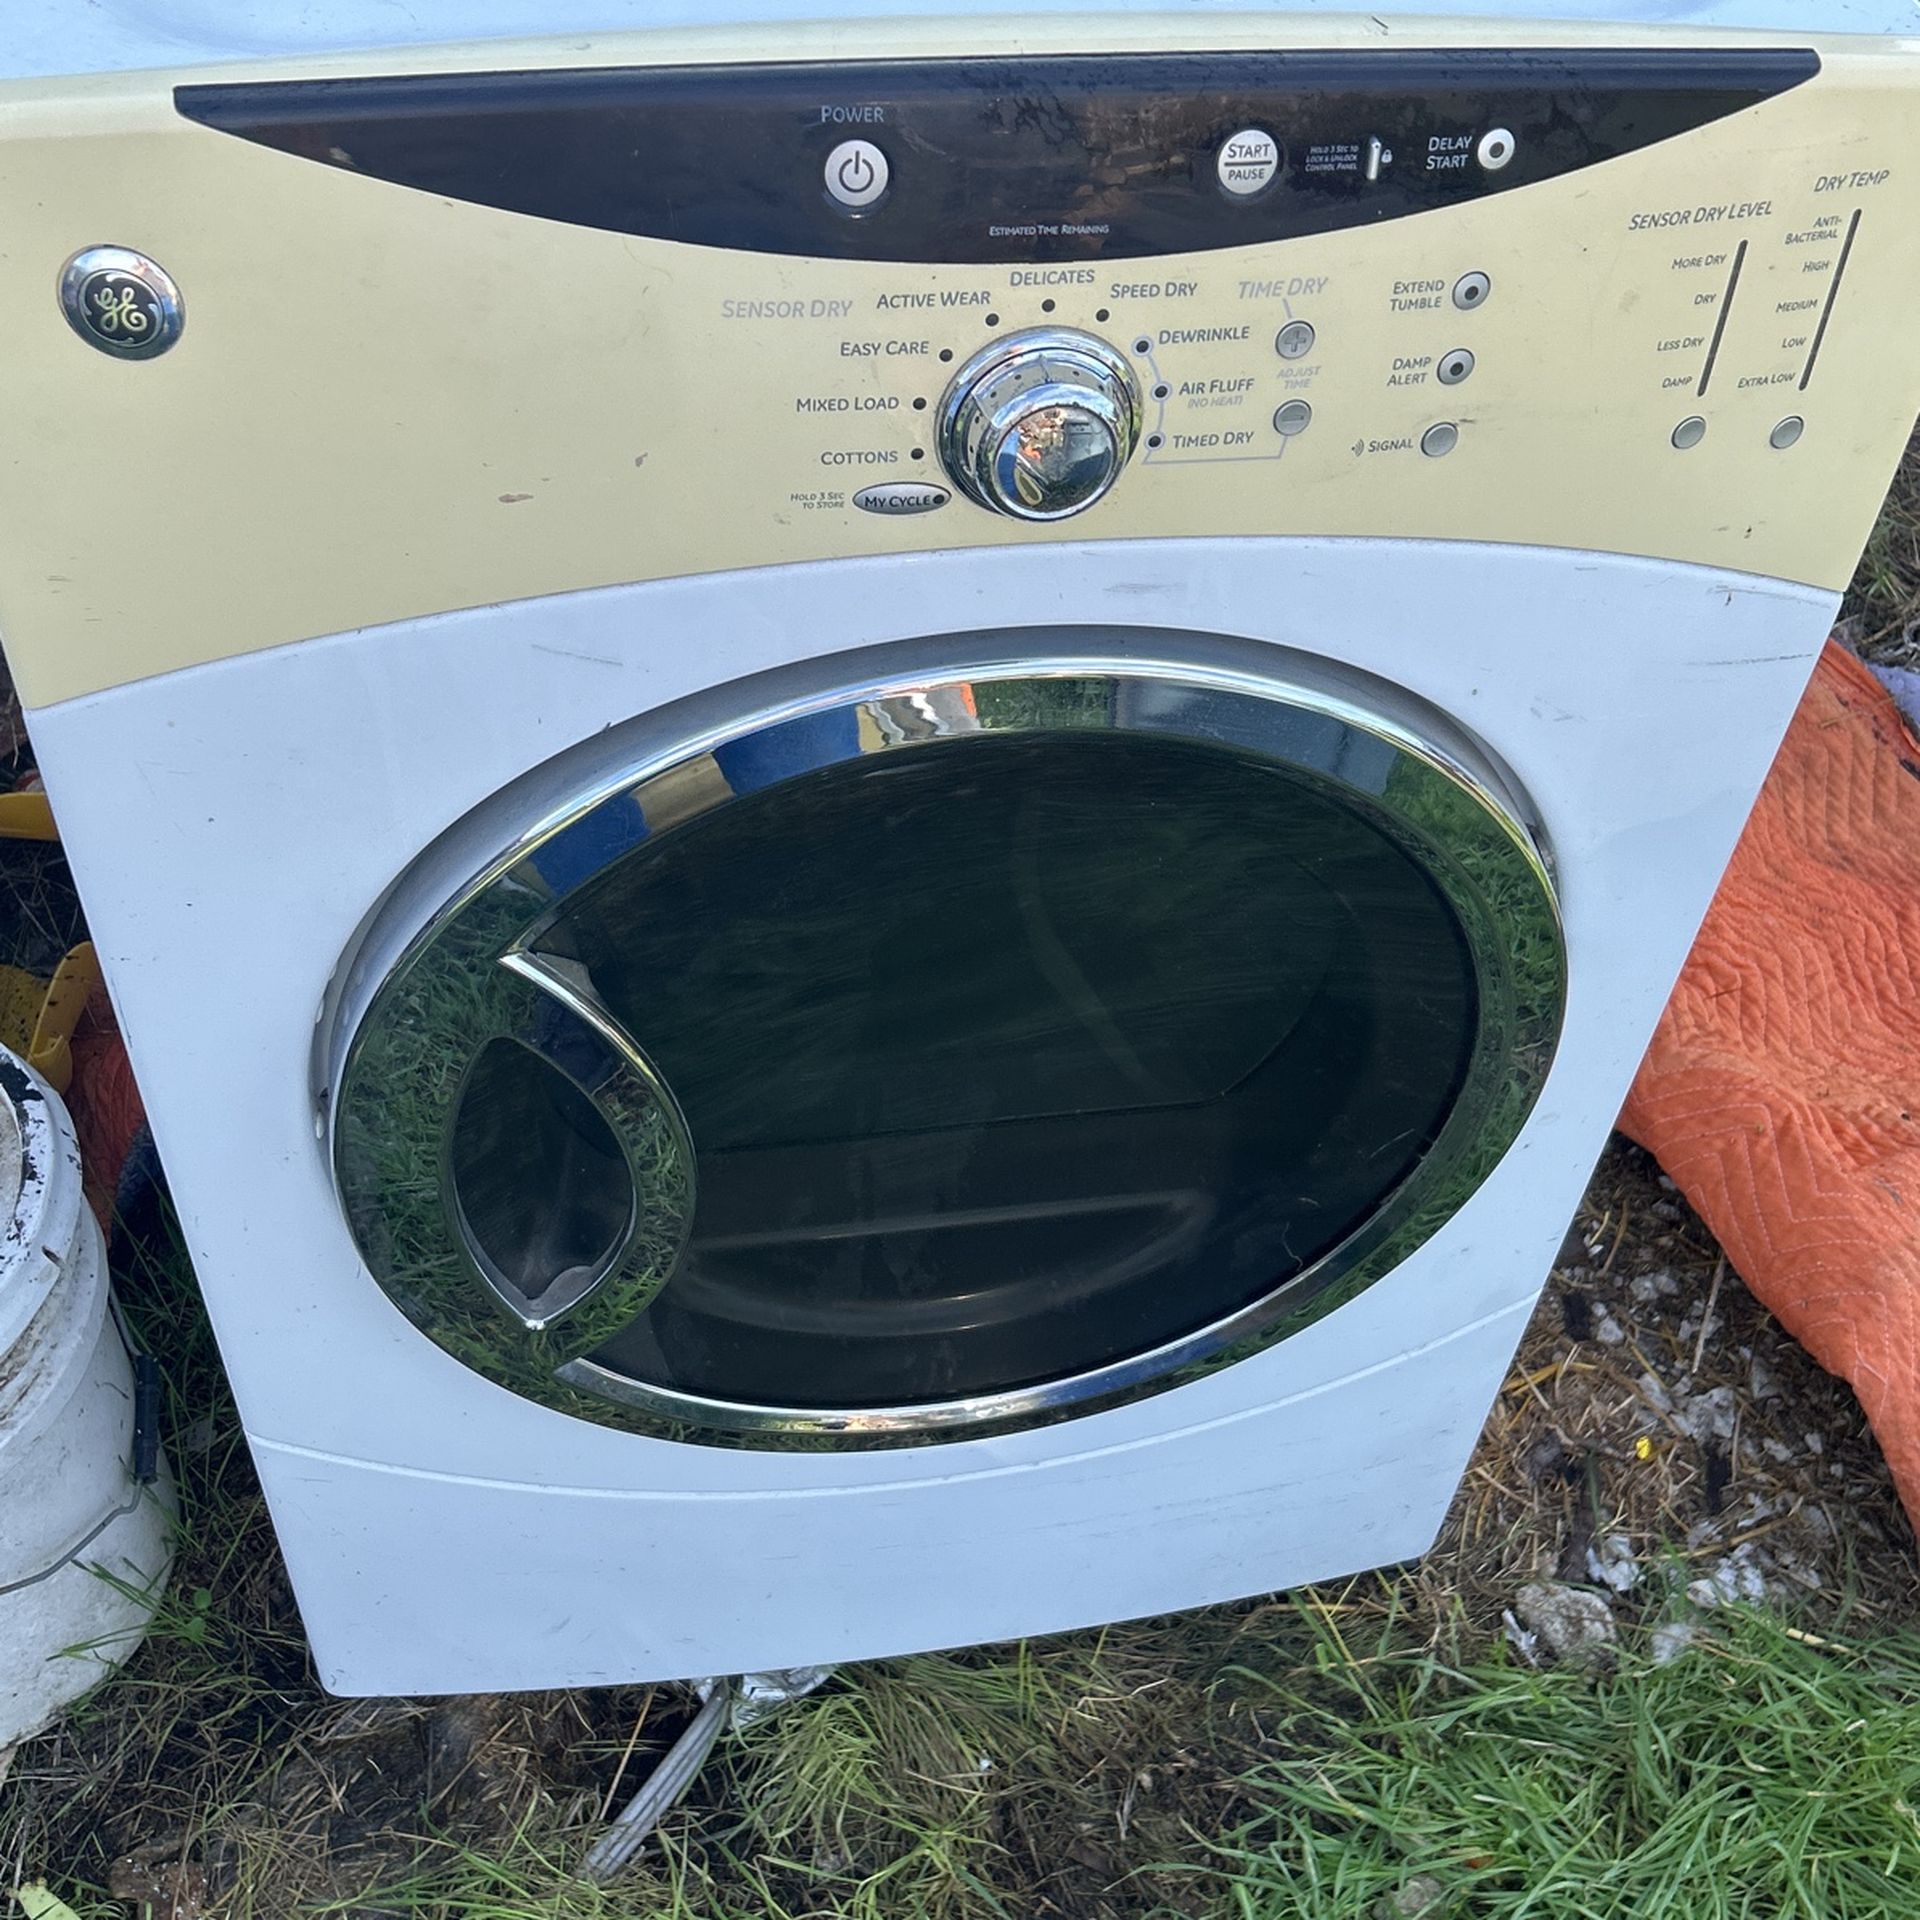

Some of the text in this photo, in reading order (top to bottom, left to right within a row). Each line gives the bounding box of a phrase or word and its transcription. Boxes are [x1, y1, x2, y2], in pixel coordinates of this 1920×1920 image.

[821, 105, 884, 123] POWER
[1227, 143, 1271, 158] START
[1428, 136, 1473, 151] DELAY
[1305, 162, 1357, 172] CONTROL PANEL
[1426, 154, 1468, 170] START
[1228, 168, 1265, 180] PAUSE
[1814, 169, 1890, 193] DRY TEMP
[1628, 200, 1773, 231] SENSOR DRY LEVEL
[1813, 216, 1843, 228] ANTI-
[989, 224, 1110, 236] ESTIMATED TIME REMAINING
[1785, 228, 1838, 245] BACTERIAL
[1671, 254, 1727, 269] MORE DRY
[1802, 260, 1830, 273] HIGH
[1010, 269, 1095, 287] DELICATES
[1110, 282, 1198, 299] SPEED DRY
[1238, 278, 1328, 299] TIME DRY
[1393, 280, 1445, 295] EXTEND
[876, 291, 991, 309] ACTIVE WEAR
[1390, 297, 1442, 311] TUMBLE
[1694, 294, 1717, 305] DRY
[1775, 299, 1818, 312] MEDIUM
[721, 298, 853, 318] SENSOR DRY
[1158, 326, 1250, 345] DEWRINKLE
[1782, 337, 1807, 348] LOW
[840, 341, 929, 356] EASY CARE
[1657, 337, 1705, 351] LESS DRY
[1392, 357, 1432, 370] DAMP
[1276, 366, 1321, 379] ADJUST
[1387, 372, 1428, 387] ALERT
[1178, 378, 1255, 395] AIR FLUFF
[1284, 379, 1312, 390] TIME
[1662, 376, 1693, 388] DAMP
[1738, 373, 1796, 388] EXTRA LOW
[796, 397, 900, 412] MIXED LOAD
[1172, 431, 1255, 448] TIMED DRY
[1368, 438, 1414, 452] SIGNAL
[820, 450, 898, 465] COTTONS
[790, 492, 845, 501] HOLD 3 SEC
[864, 495, 931, 508] MY CYCLE
[816, 500, 845, 509] STORE
